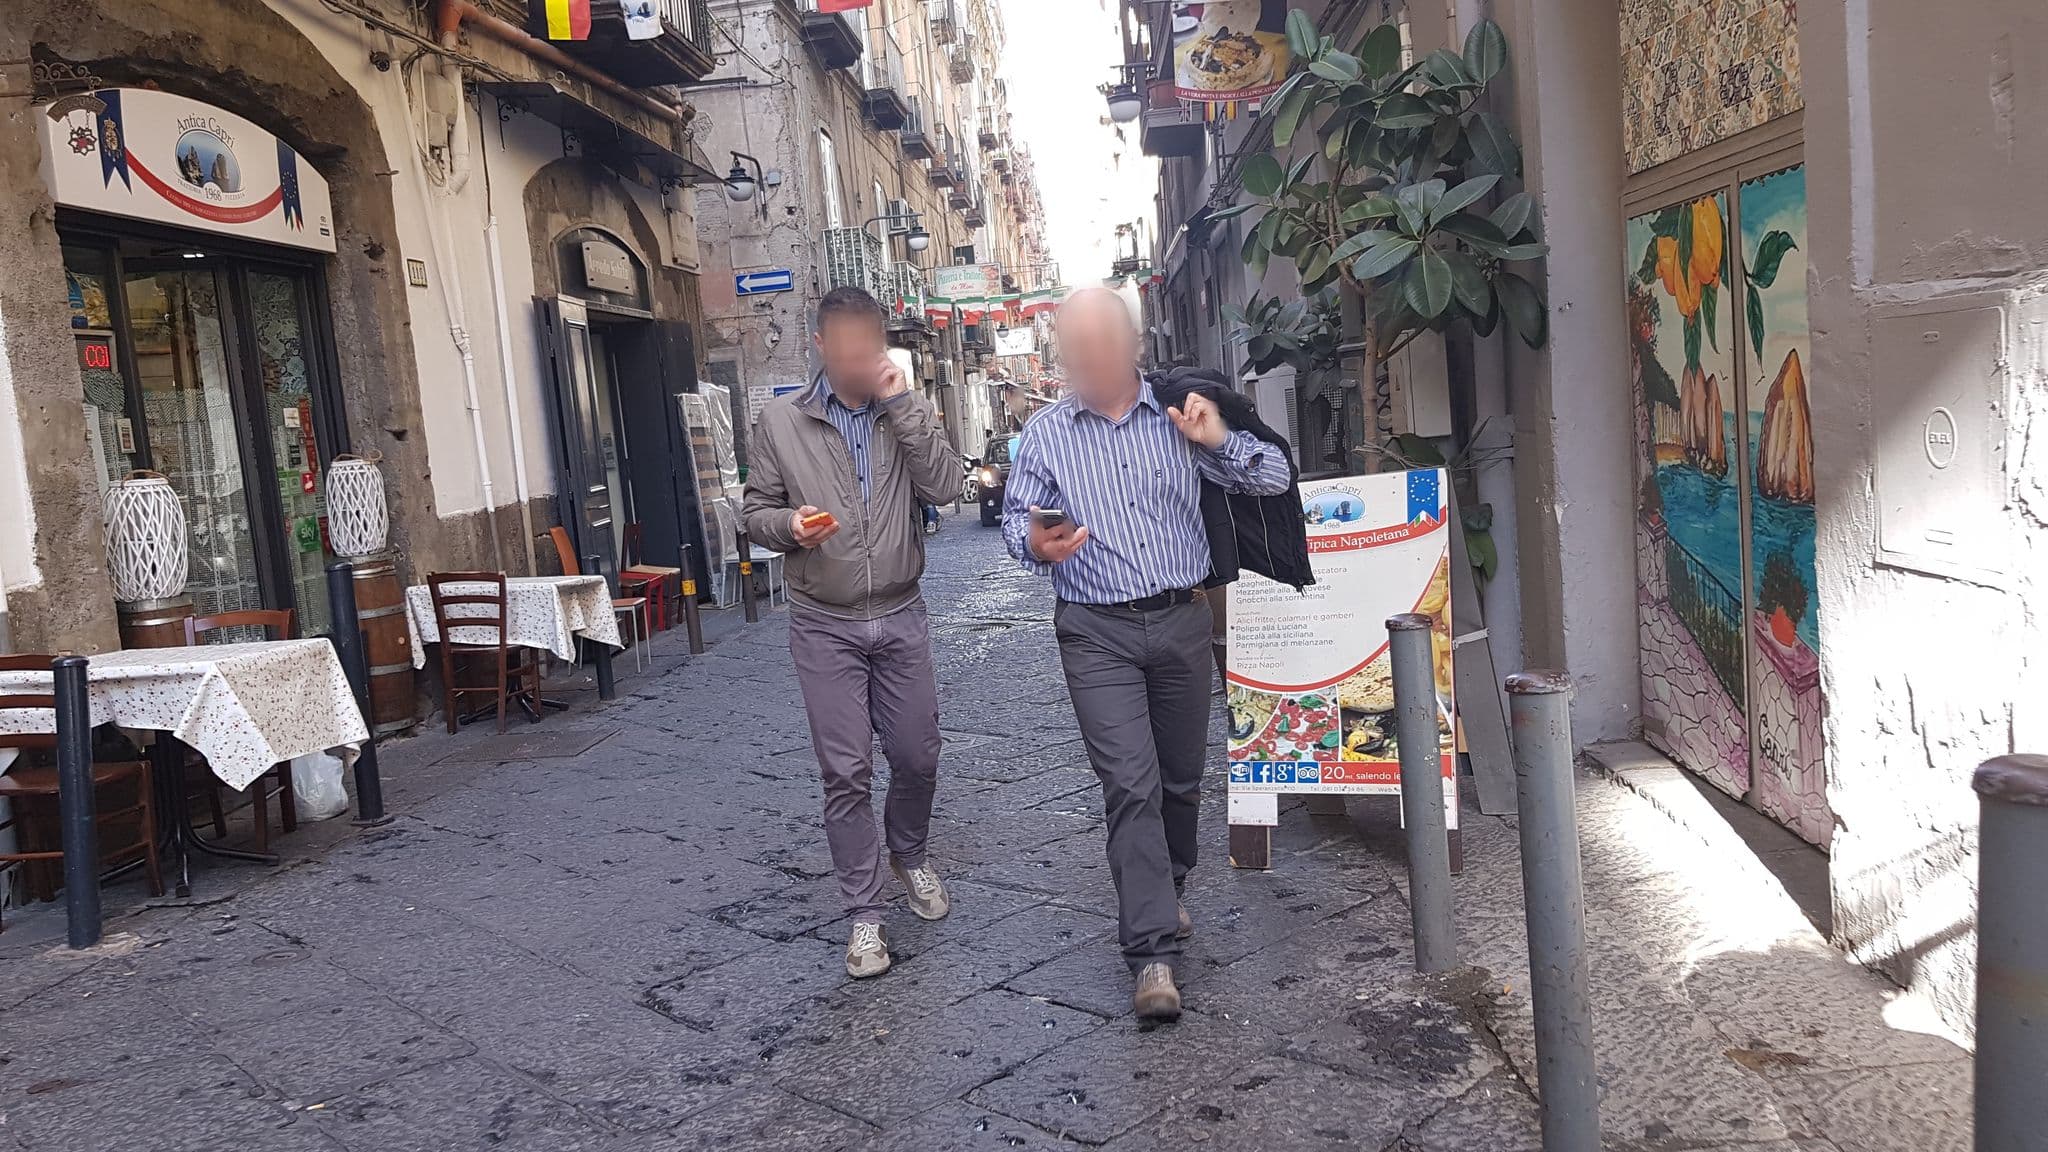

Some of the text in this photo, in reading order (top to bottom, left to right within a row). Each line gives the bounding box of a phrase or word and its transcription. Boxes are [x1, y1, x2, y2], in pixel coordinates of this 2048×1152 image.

[177, 113, 236, 148] Antica Capri
[205, 187, 222, 201] 1968
[1304, 482, 1362, 500] Antica Capri
[1324, 522, 1341, 530] 1968
[1340, 527, 1410, 548] Napoletana
[1312, 567, 1347, 575] escatora
[1236, 580, 1273, 588] Spaghetti
[1236, 587, 1275, 596] Mezzanelli
[1269, 595, 1283, 603] alla
[1277, 614, 1311, 622] calamari
[1320, 612, 1354, 622] gamberi
[1236, 623, 1308, 633] Polipo alla Luciana
[1236, 631, 1314, 641] Baccalà alla siciliana
[1236, 640, 1279, 649] Parmigiana
[1290, 638, 1334, 647] melanzane
[1237, 661, 1285, 670] Pizza Napoli
[1323, 766, 1345, 780] 20
[1355, 771, 1391, 780] salendo
